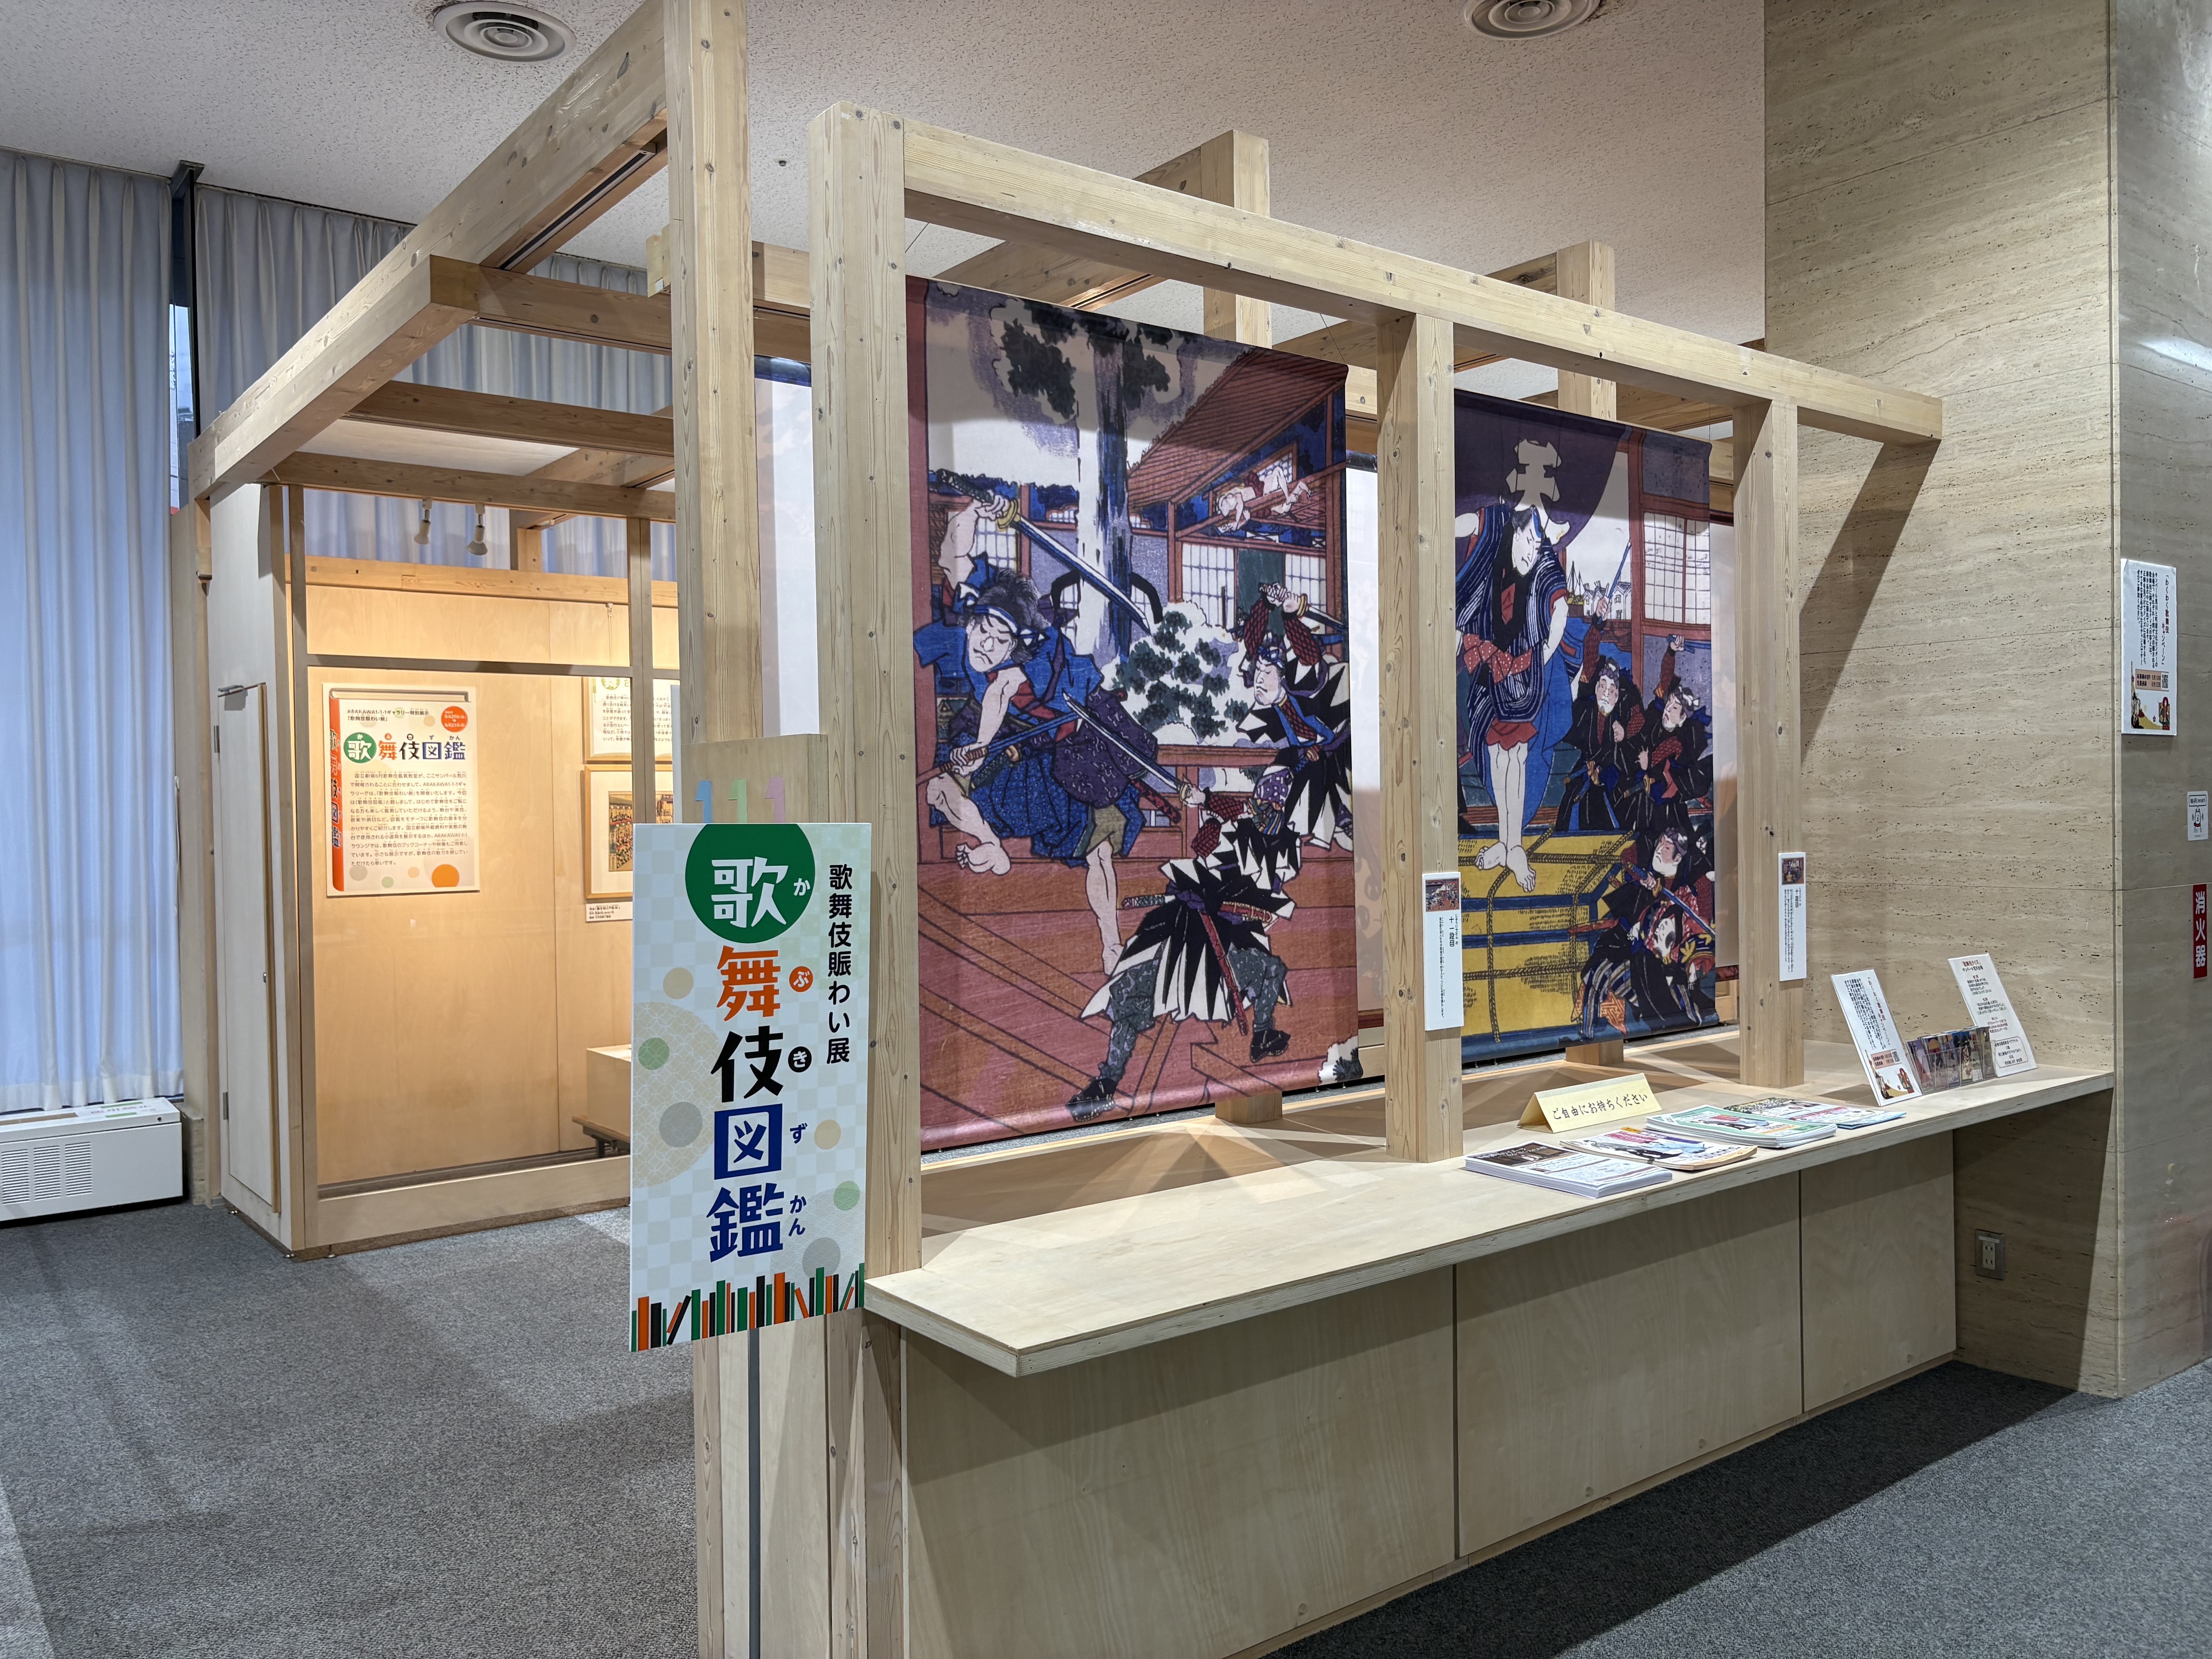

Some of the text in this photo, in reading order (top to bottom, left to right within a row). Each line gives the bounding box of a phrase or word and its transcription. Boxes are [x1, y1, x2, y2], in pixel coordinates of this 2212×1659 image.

[348, 740, 466, 760] 歌舞伎図鑑
[793, 878, 810, 896] か
[2195, 891, 2206, 967] 消火器
[826, 864, 852, 1064] 歌舞伎賑わい展
[707, 856, 788, 1262] 歌舞伎図鑑
[1553, 1094, 1647, 1120] ご自由にお持ちください
[790, 1123, 807, 1144] ず
[788, 1195, 807, 1237] かん
